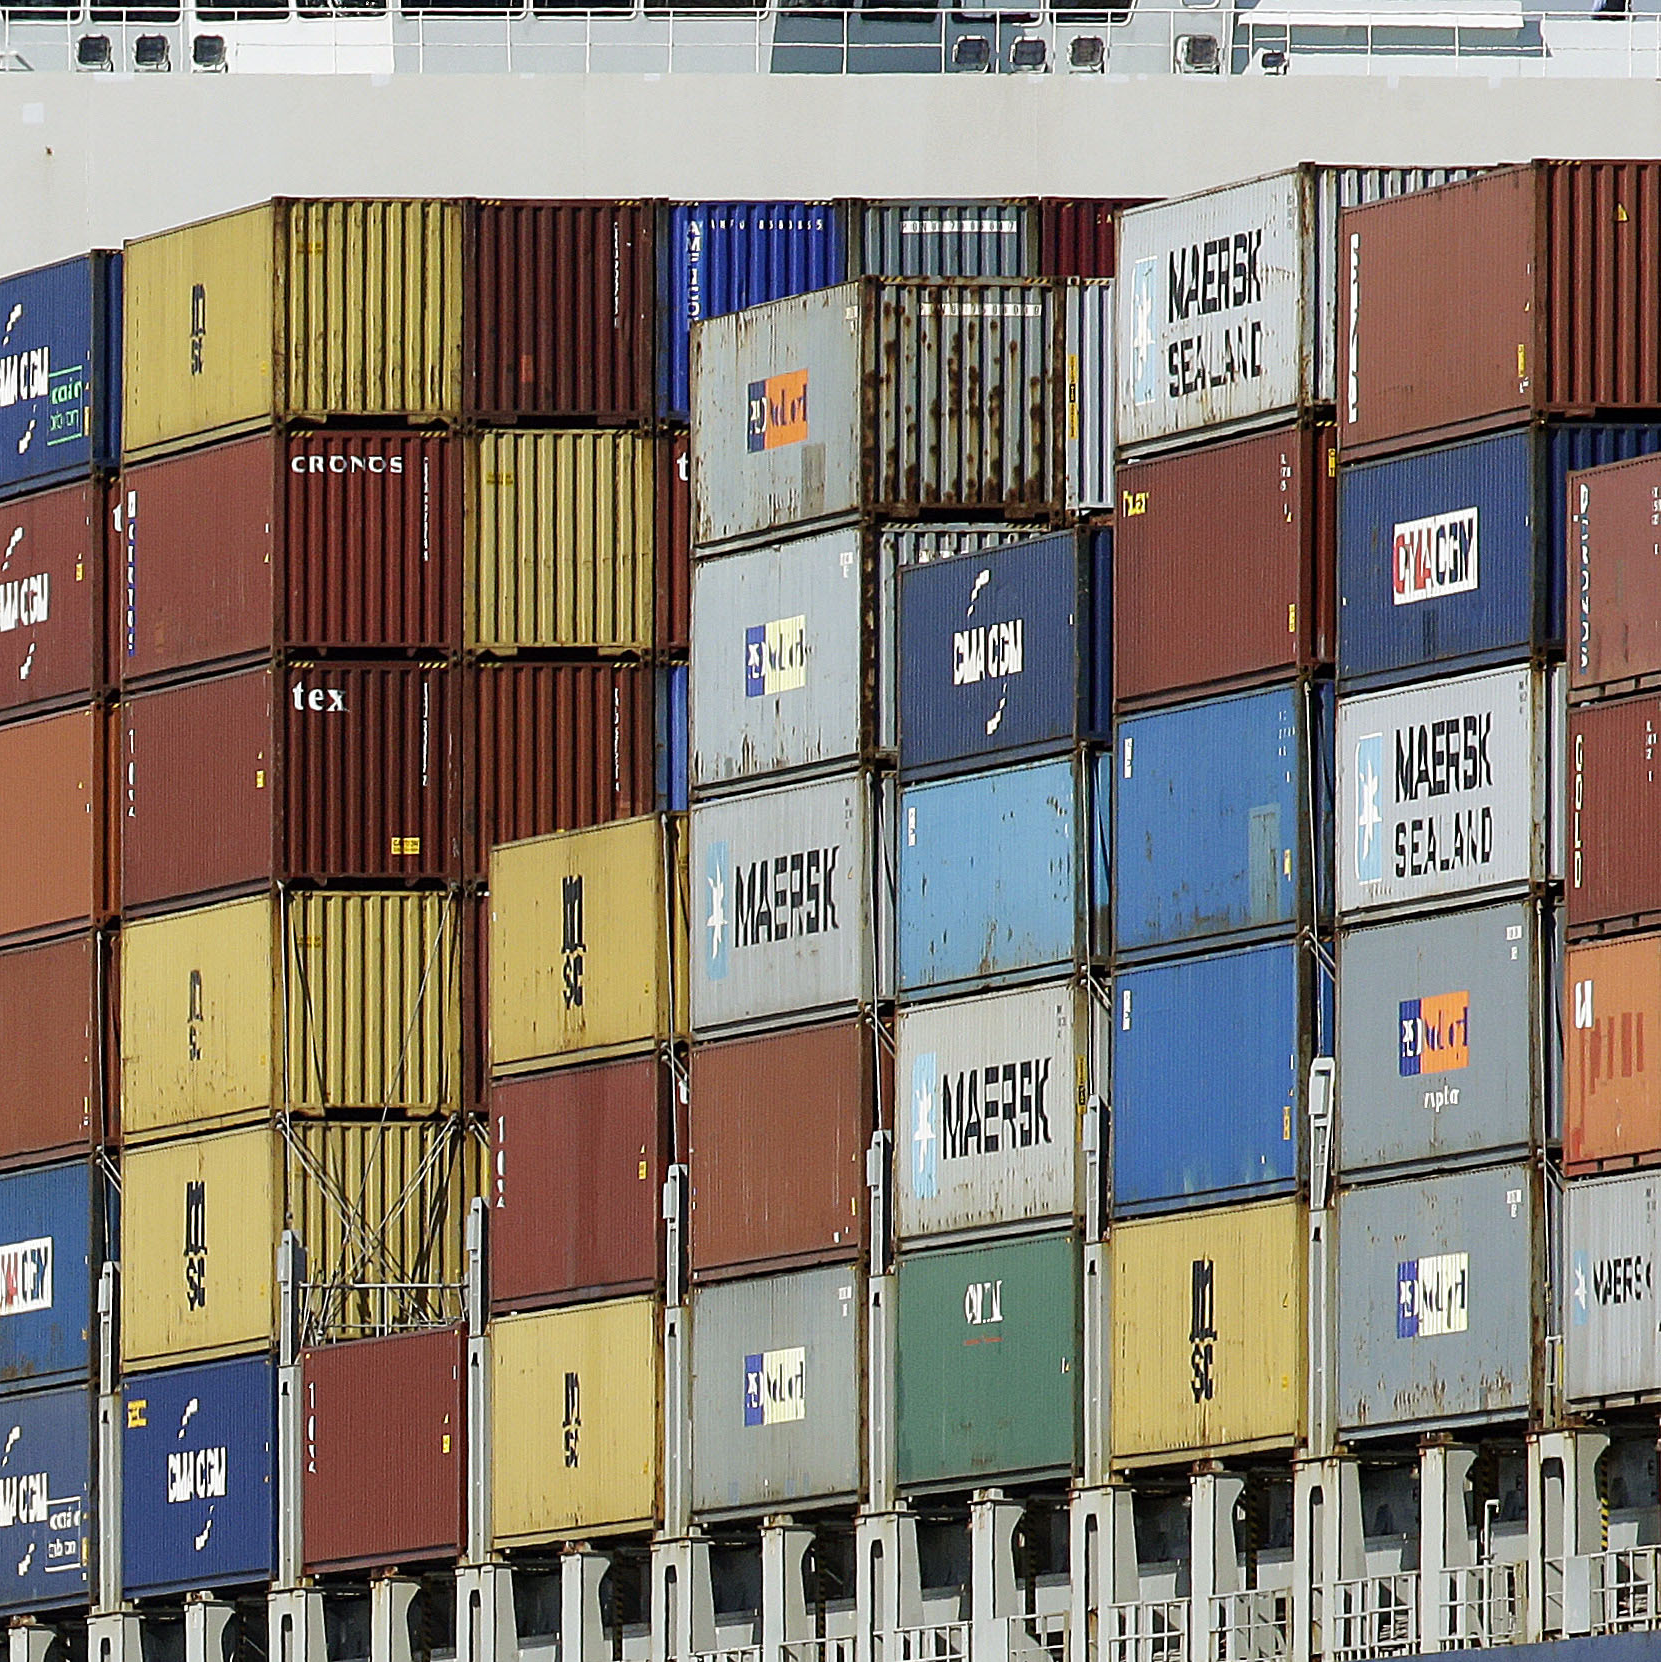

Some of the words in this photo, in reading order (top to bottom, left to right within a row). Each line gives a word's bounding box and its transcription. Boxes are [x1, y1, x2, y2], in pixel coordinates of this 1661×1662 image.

[1168, 228, 1262, 324] MAERSK
[291, 455, 402, 473] CRONOS
[292, 681, 351, 712] tex
[1395, 710, 1493, 804] MAERSK
[1574, 733, 1584, 889] GOLD
[735, 845, 840, 949] MAERSK
[943, 1057, 1053, 1160] MAERSK
